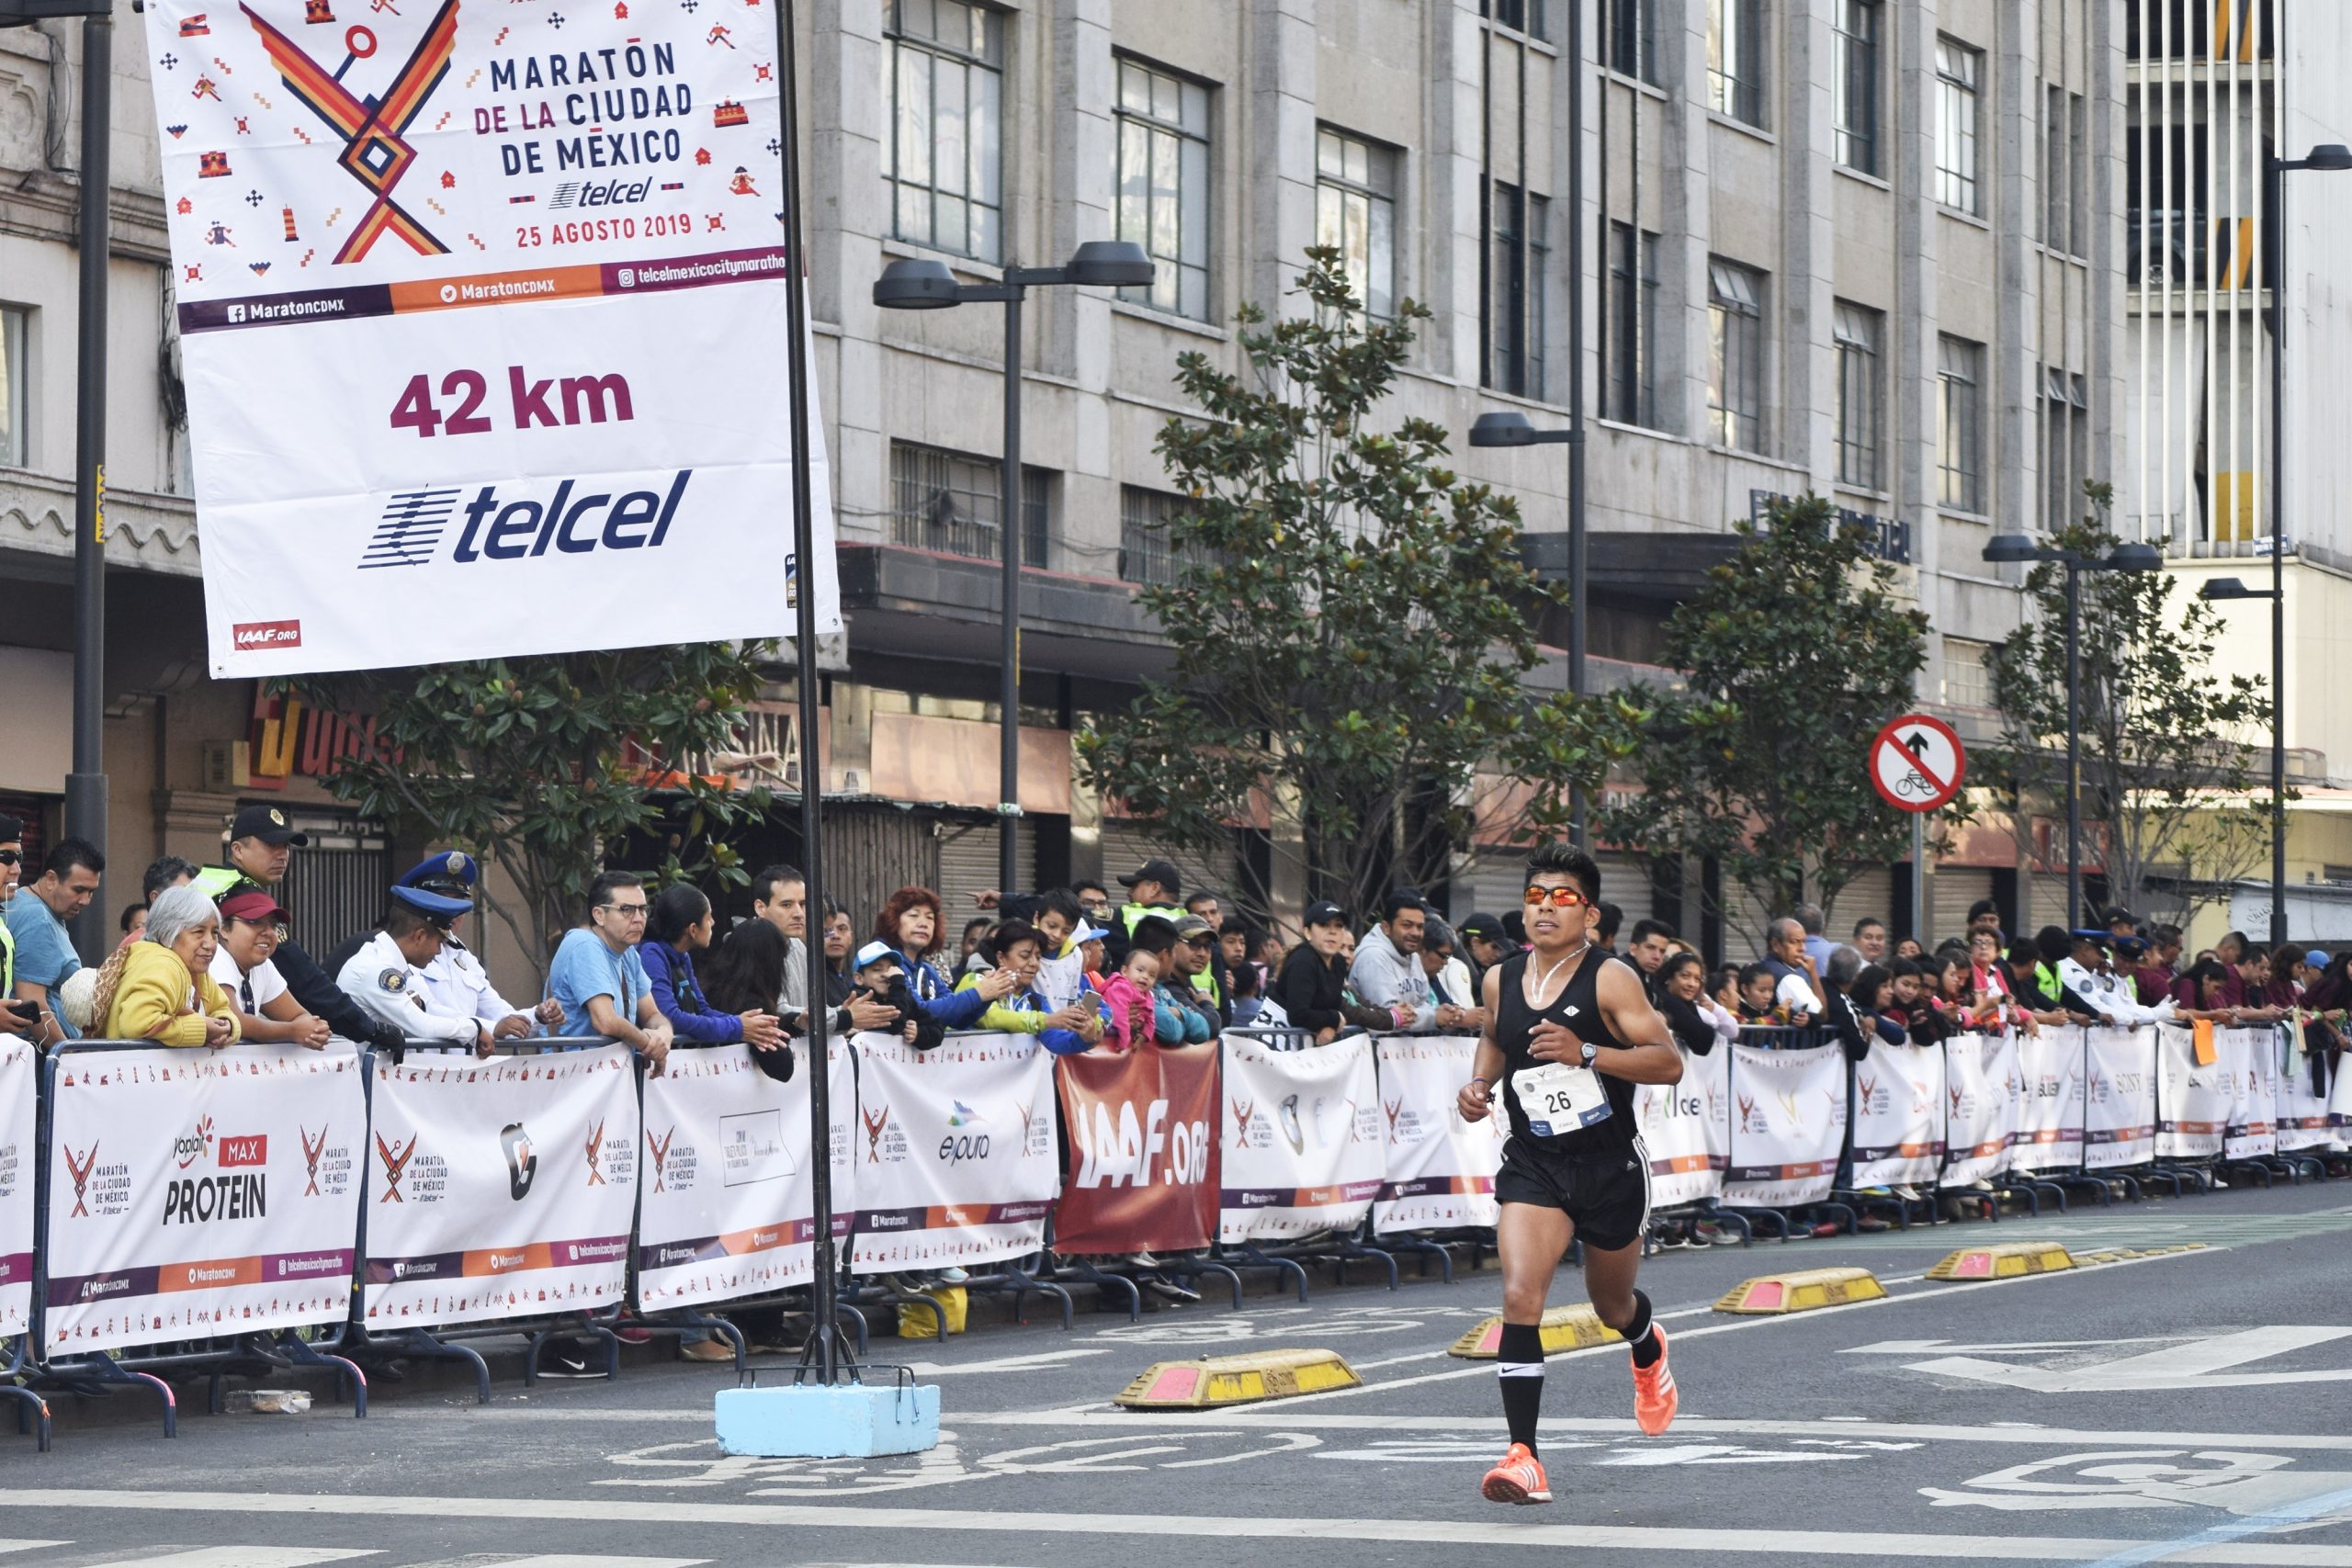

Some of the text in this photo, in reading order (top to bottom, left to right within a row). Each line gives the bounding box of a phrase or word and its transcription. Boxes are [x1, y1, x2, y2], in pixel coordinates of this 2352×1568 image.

[491, 38, 675, 92] MARATÓN
[475, 84, 692, 135] DE LA CIUDAD
[502, 128, 681, 176] DE MÉXICO
[578, 176, 653, 208] telcel
[516, 213, 692, 248] 25 AGOSTO 2019
[638, 254, 786, 284] telcelmexicocitymaratho
[461, 278, 556, 300] MaratonCDMX
[250, 299, 345, 320] MaratonCDMX
[390, 365, 634, 437] 42 km
[453, 469, 693, 563] telcel
[238, 629, 298, 643] IAAF.ORG
[1545, 1091, 1571, 1113] 26
[228, 1140, 258, 1162] MAX
[92, 1177, 131, 1190] DE LA CIUDAD
[96, 1163, 129, 1177] MARATÓN
[96, 1190, 129, 1204] DE MÉXICO
[163, 1173, 266, 1226] PROTEIN
